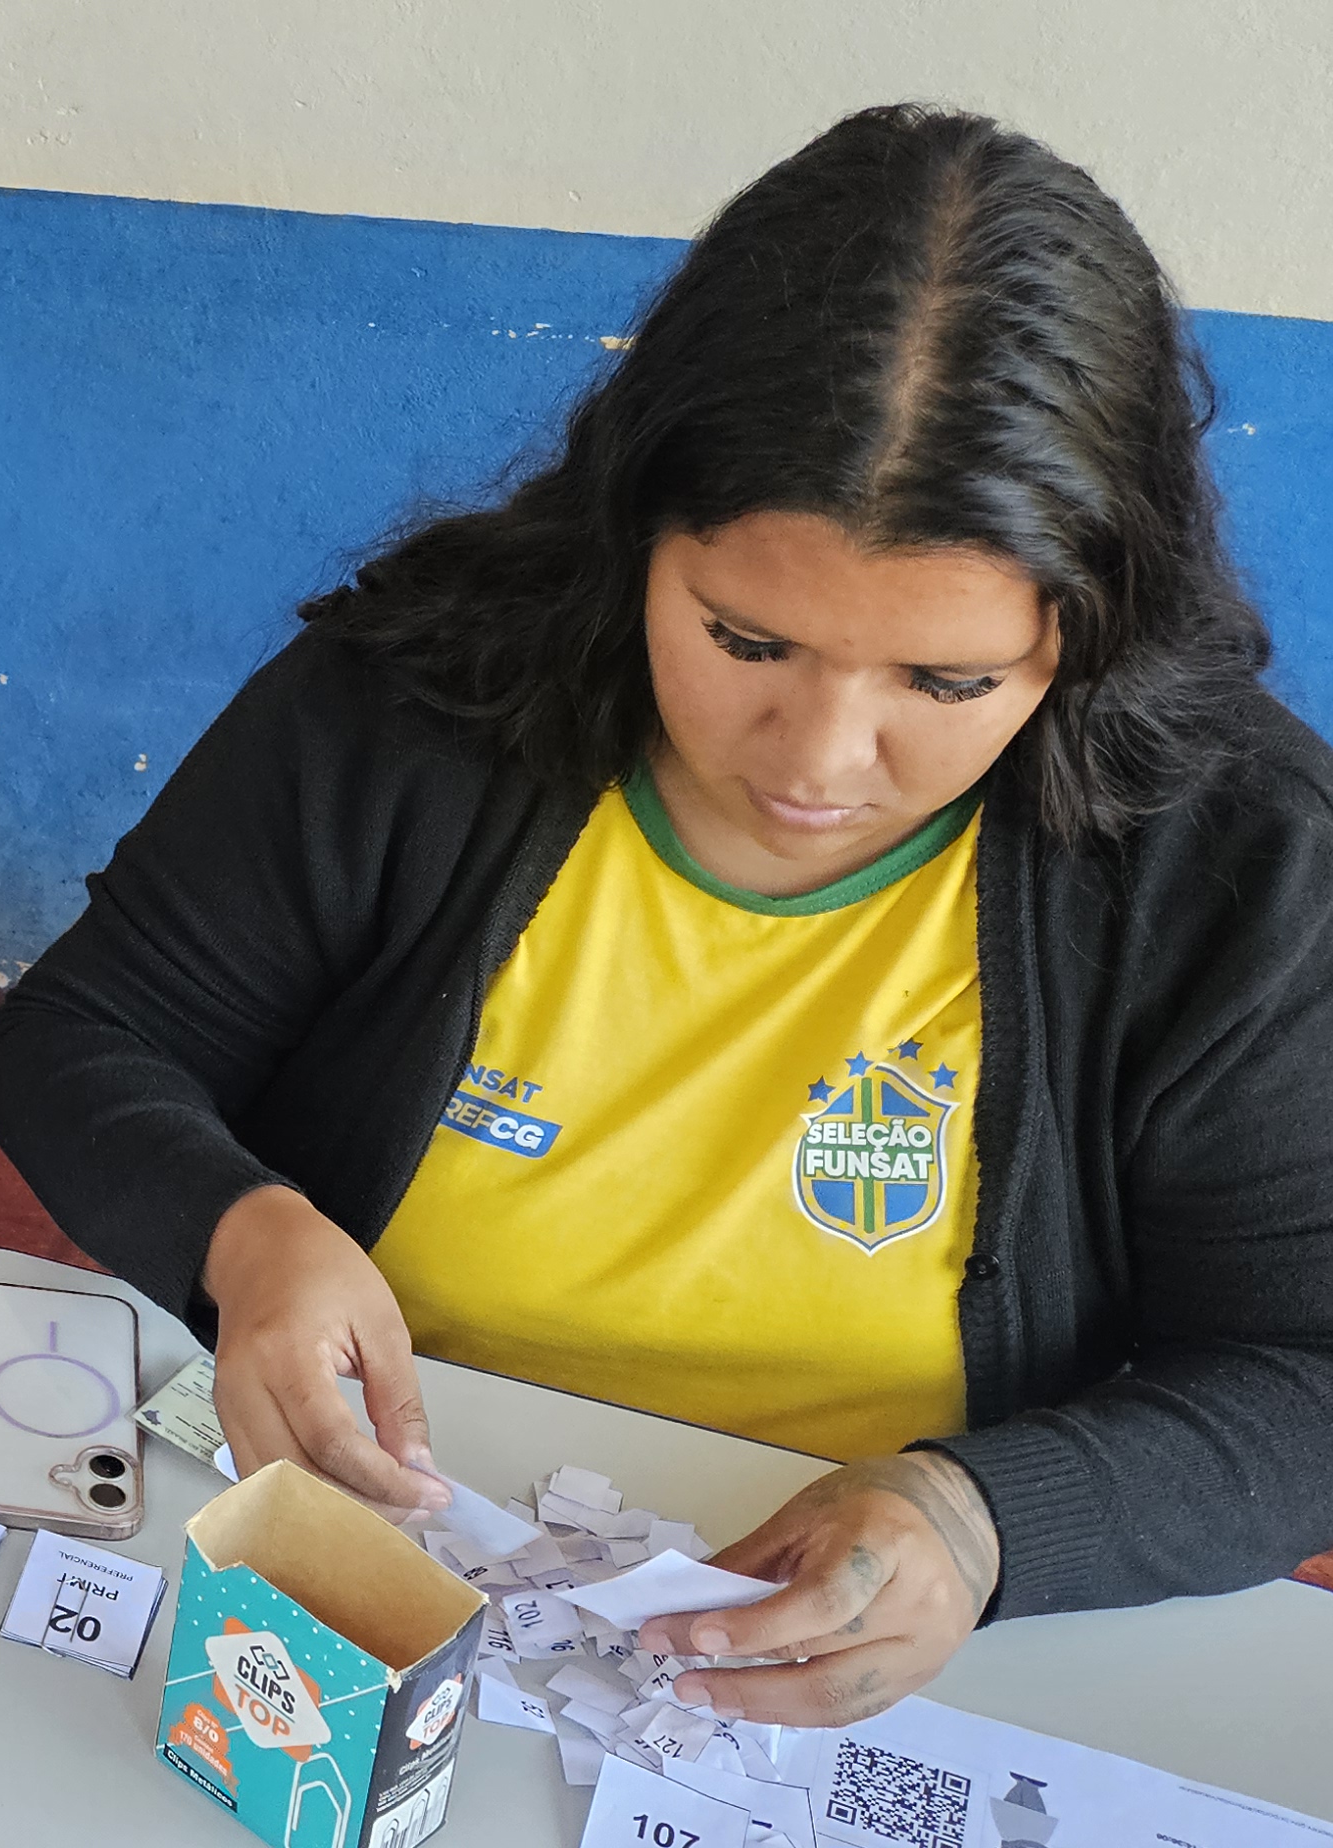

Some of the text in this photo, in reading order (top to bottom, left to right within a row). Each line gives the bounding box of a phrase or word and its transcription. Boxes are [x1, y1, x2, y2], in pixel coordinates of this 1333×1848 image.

[459, 1062, 543, 1104] NSAT
[805, 1120, 932, 1154] SELEÇÃO
[805, 1149, 934, 1181] FUNSAT
[58, 1550, 134, 1582] PREFERENCIAL
[56, 1571, 120, 1601] PRIMT
[48, 1603, 103, 1643] 02
[514, 1600, 544, 1628] 102
[487, 1628, 513, 1652] 116
[236, 1655, 297, 1716] CLIPS
[234, 1683, 292, 1737] TOP
[422, 1710, 455, 1740] TOP
[423, 1693, 453, 1725] CLIPS
[193, 1715, 220, 1743] 8/0
[652, 1734, 684, 1759] 127
[167, 1749, 233, 1807] Clips Metálicos
[633, 1813, 701, 1848] 107
